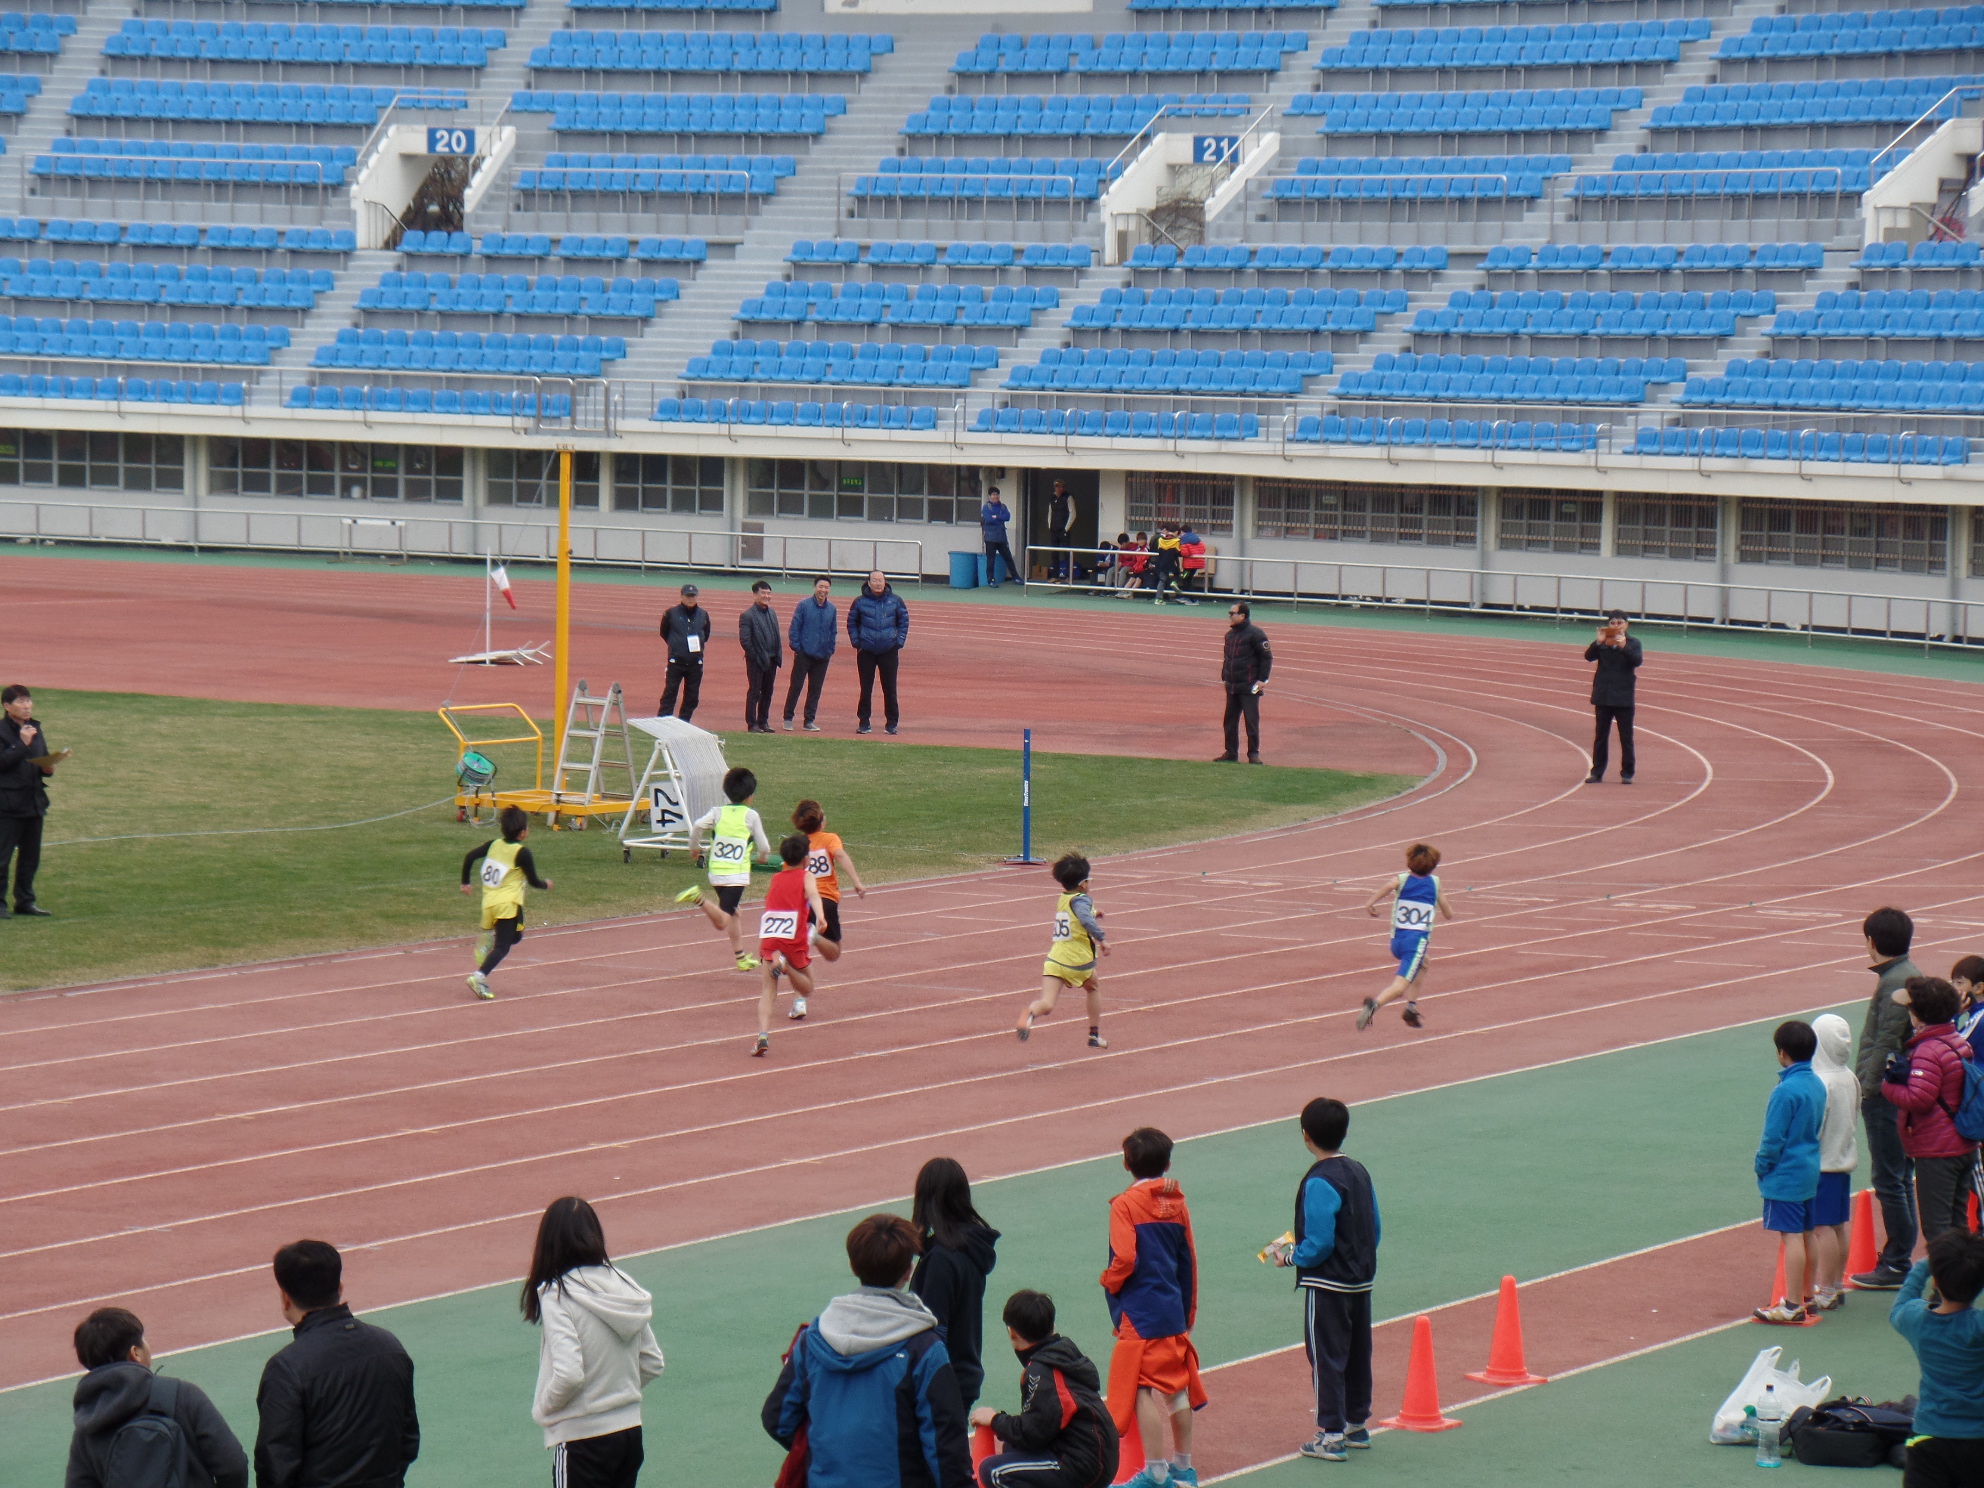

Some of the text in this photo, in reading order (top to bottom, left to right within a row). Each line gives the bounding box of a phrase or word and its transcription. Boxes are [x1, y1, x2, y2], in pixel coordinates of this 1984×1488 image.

[435, 129, 467, 153] 20
[1203, 137, 1230, 162] 21
[654, 788, 683, 827] 24
[714, 841, 744, 860] 320
[483, 865, 500, 885] 80
[764, 916, 794, 935] 272
[1397, 906, 1432, 927] 304
